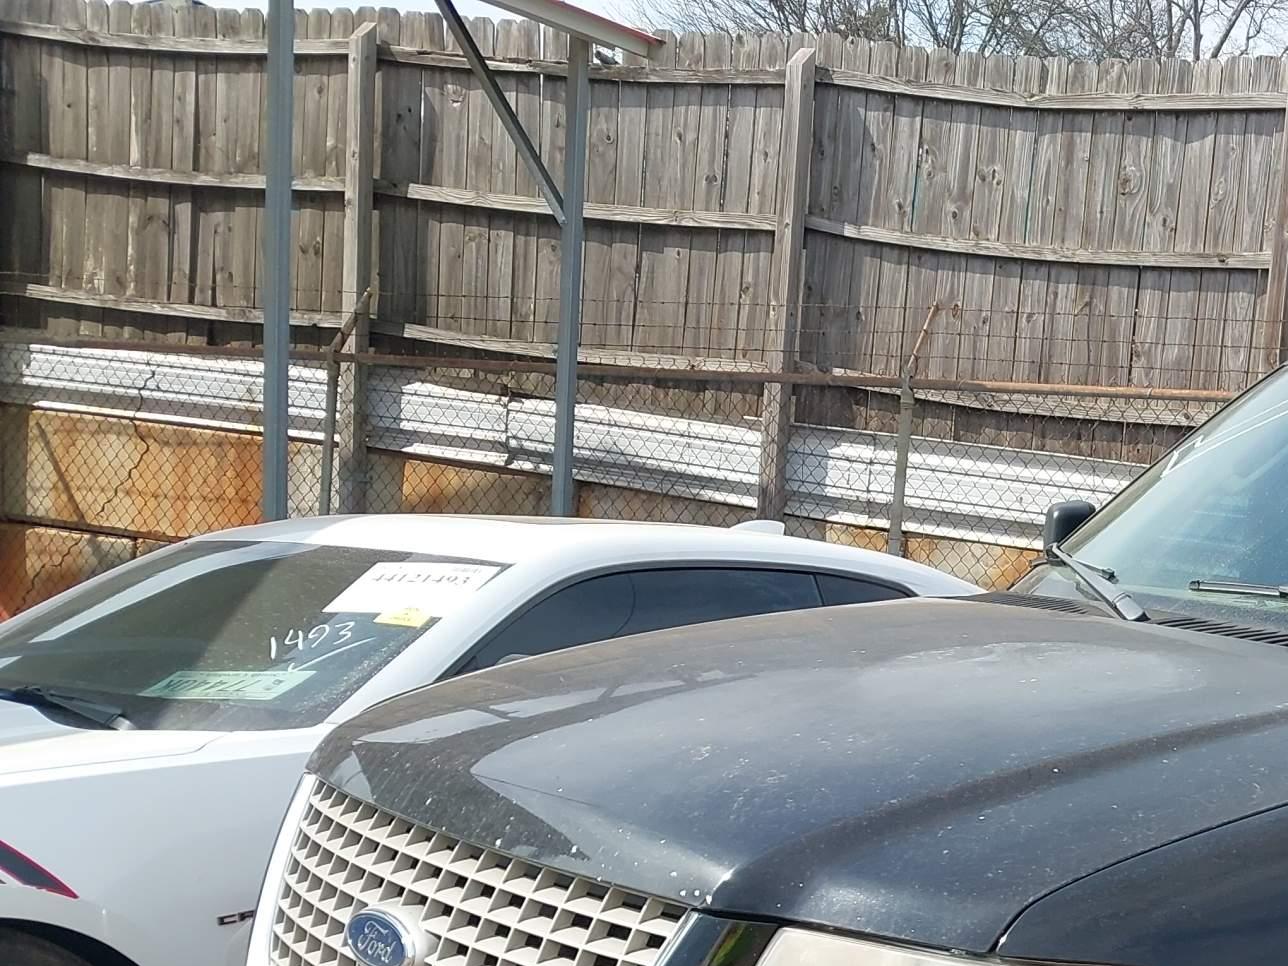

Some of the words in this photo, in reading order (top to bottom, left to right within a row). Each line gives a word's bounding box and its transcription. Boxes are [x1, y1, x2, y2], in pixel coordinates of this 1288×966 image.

[372, 573, 471, 586] 44121493
[270, 621, 356, 660] 1493
[356, 921, 397, 964] Ford
